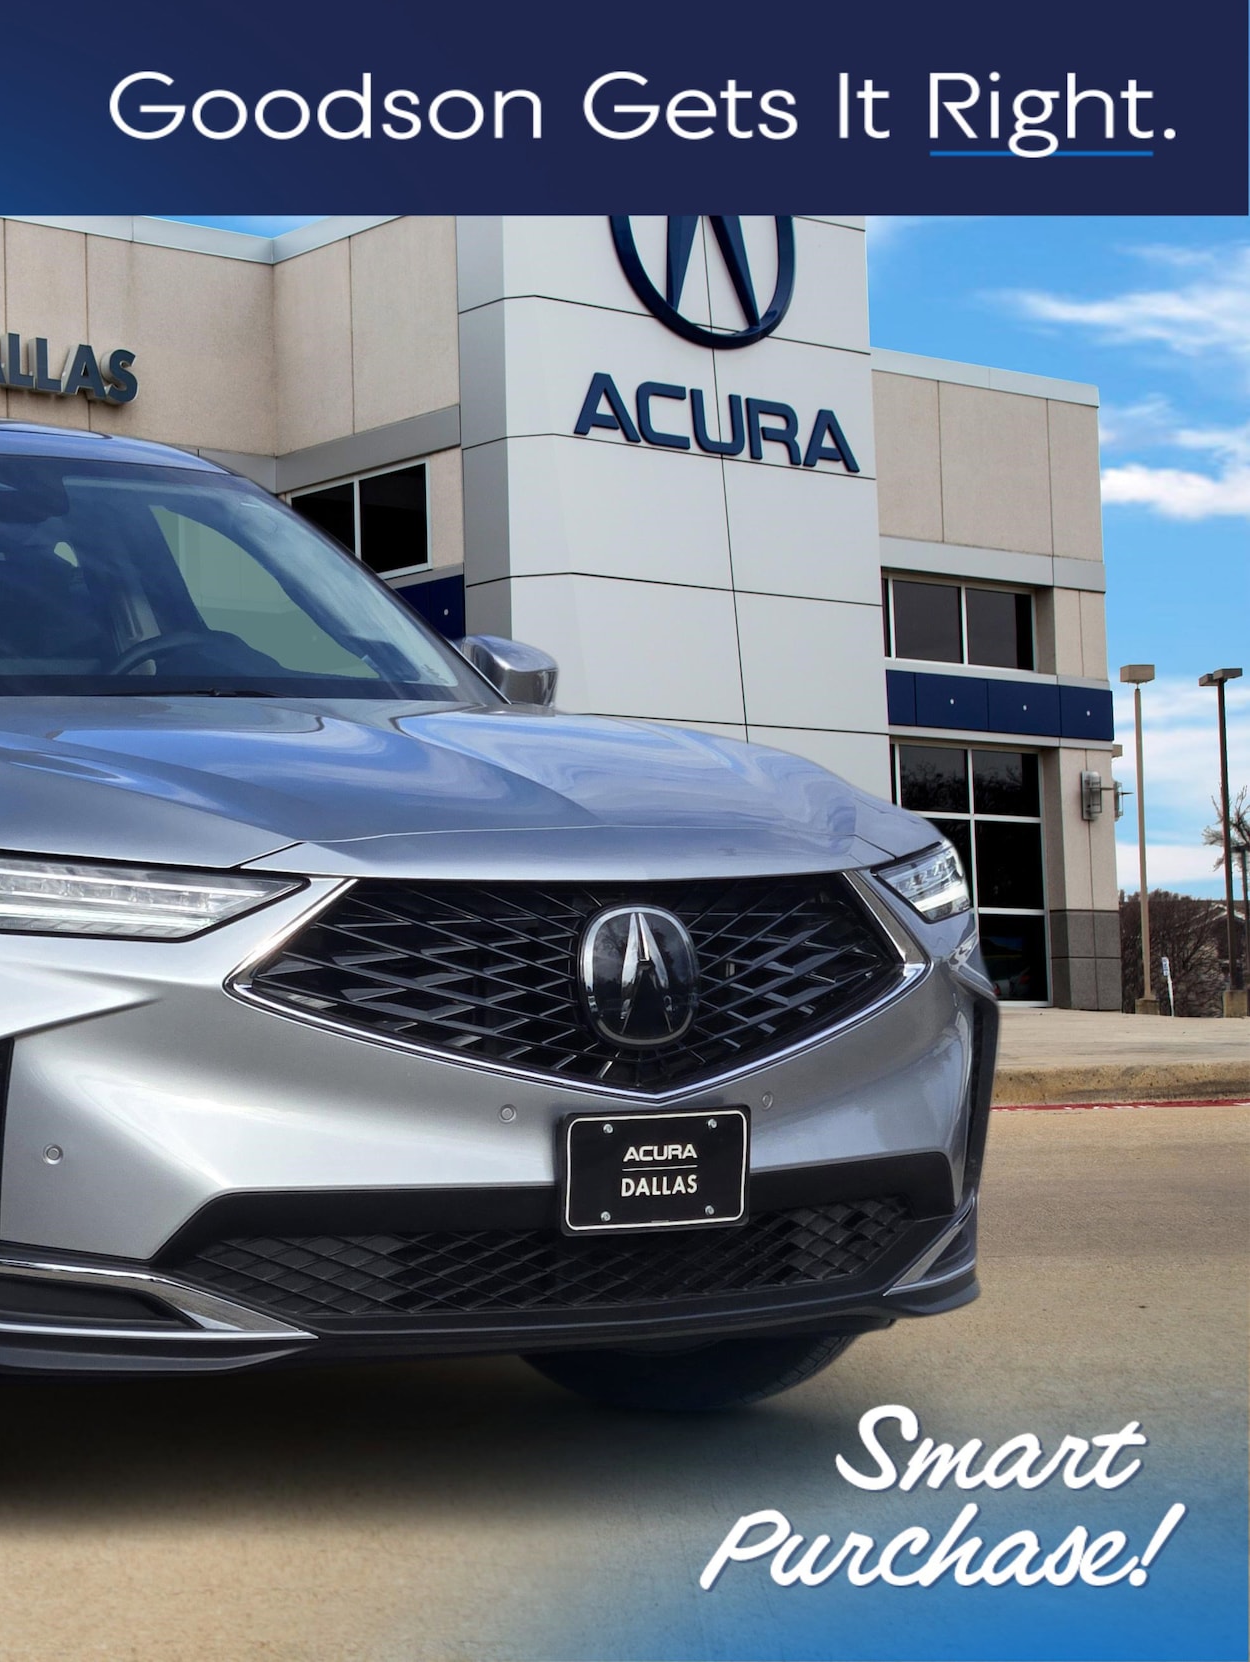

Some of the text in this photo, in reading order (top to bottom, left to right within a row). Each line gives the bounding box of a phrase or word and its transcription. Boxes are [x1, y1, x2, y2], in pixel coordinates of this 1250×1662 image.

[573, 372, 860, 473] ACURA
[622, 1143, 698, 1162] ACURA
[621, 1174, 698, 1197] DALLAS
